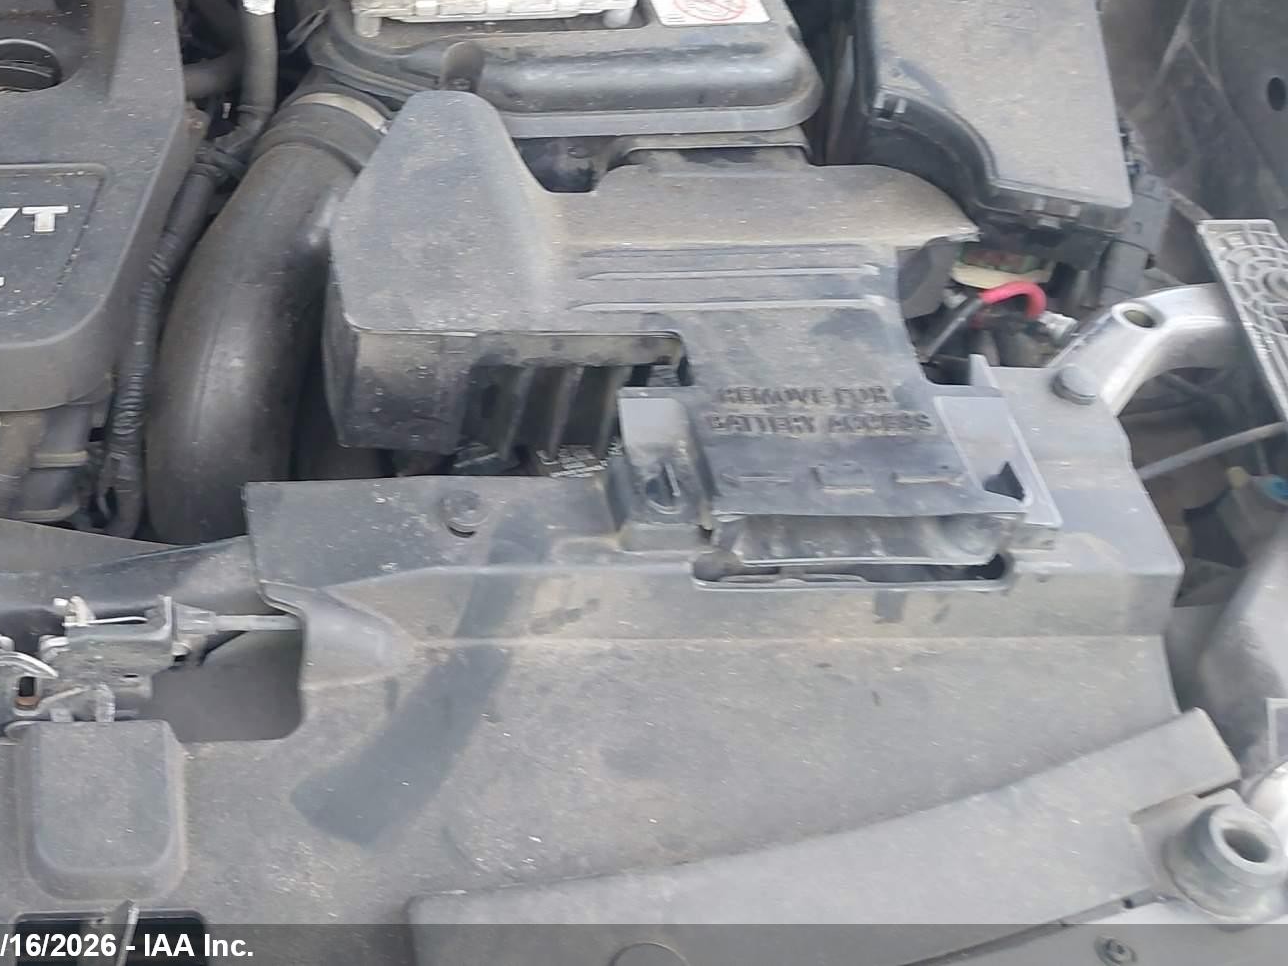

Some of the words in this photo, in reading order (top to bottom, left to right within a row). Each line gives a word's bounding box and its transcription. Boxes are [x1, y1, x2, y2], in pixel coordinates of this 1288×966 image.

[718, 386, 824, 405] REMOVE
[834, 385, 890, 404] FOR
[709, 413, 816, 434] BATTERY
[828, 411, 932, 433] ACCESS
